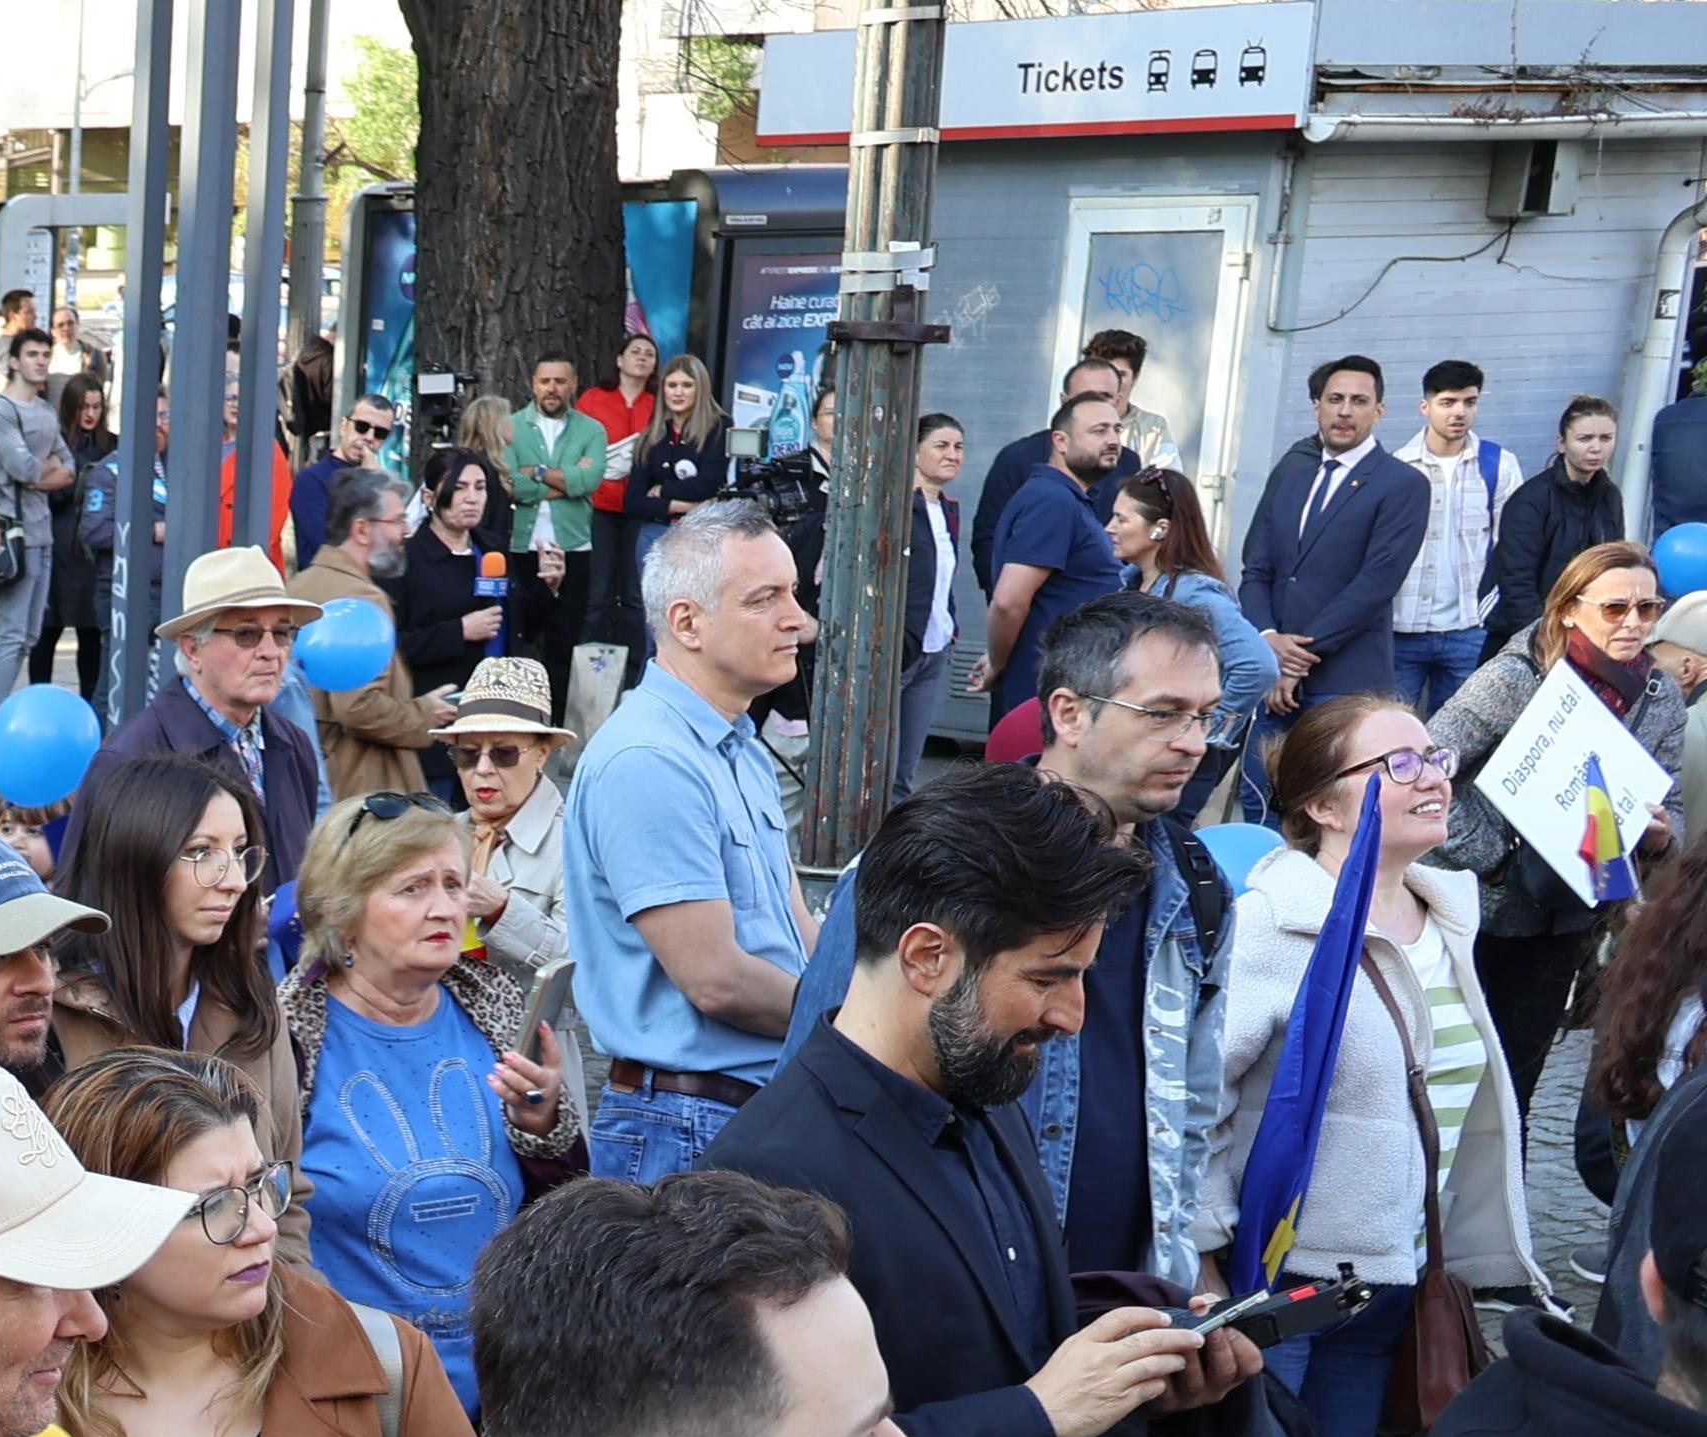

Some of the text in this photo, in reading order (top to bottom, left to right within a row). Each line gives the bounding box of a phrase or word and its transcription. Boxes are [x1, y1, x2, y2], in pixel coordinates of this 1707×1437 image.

[1017, 60, 1125, 94] Tickets
[769, 294, 806, 310] Haine
[1501, 683, 1582, 797] Diaspora, nu da!
[1617, 787, 1638, 815] ta!
